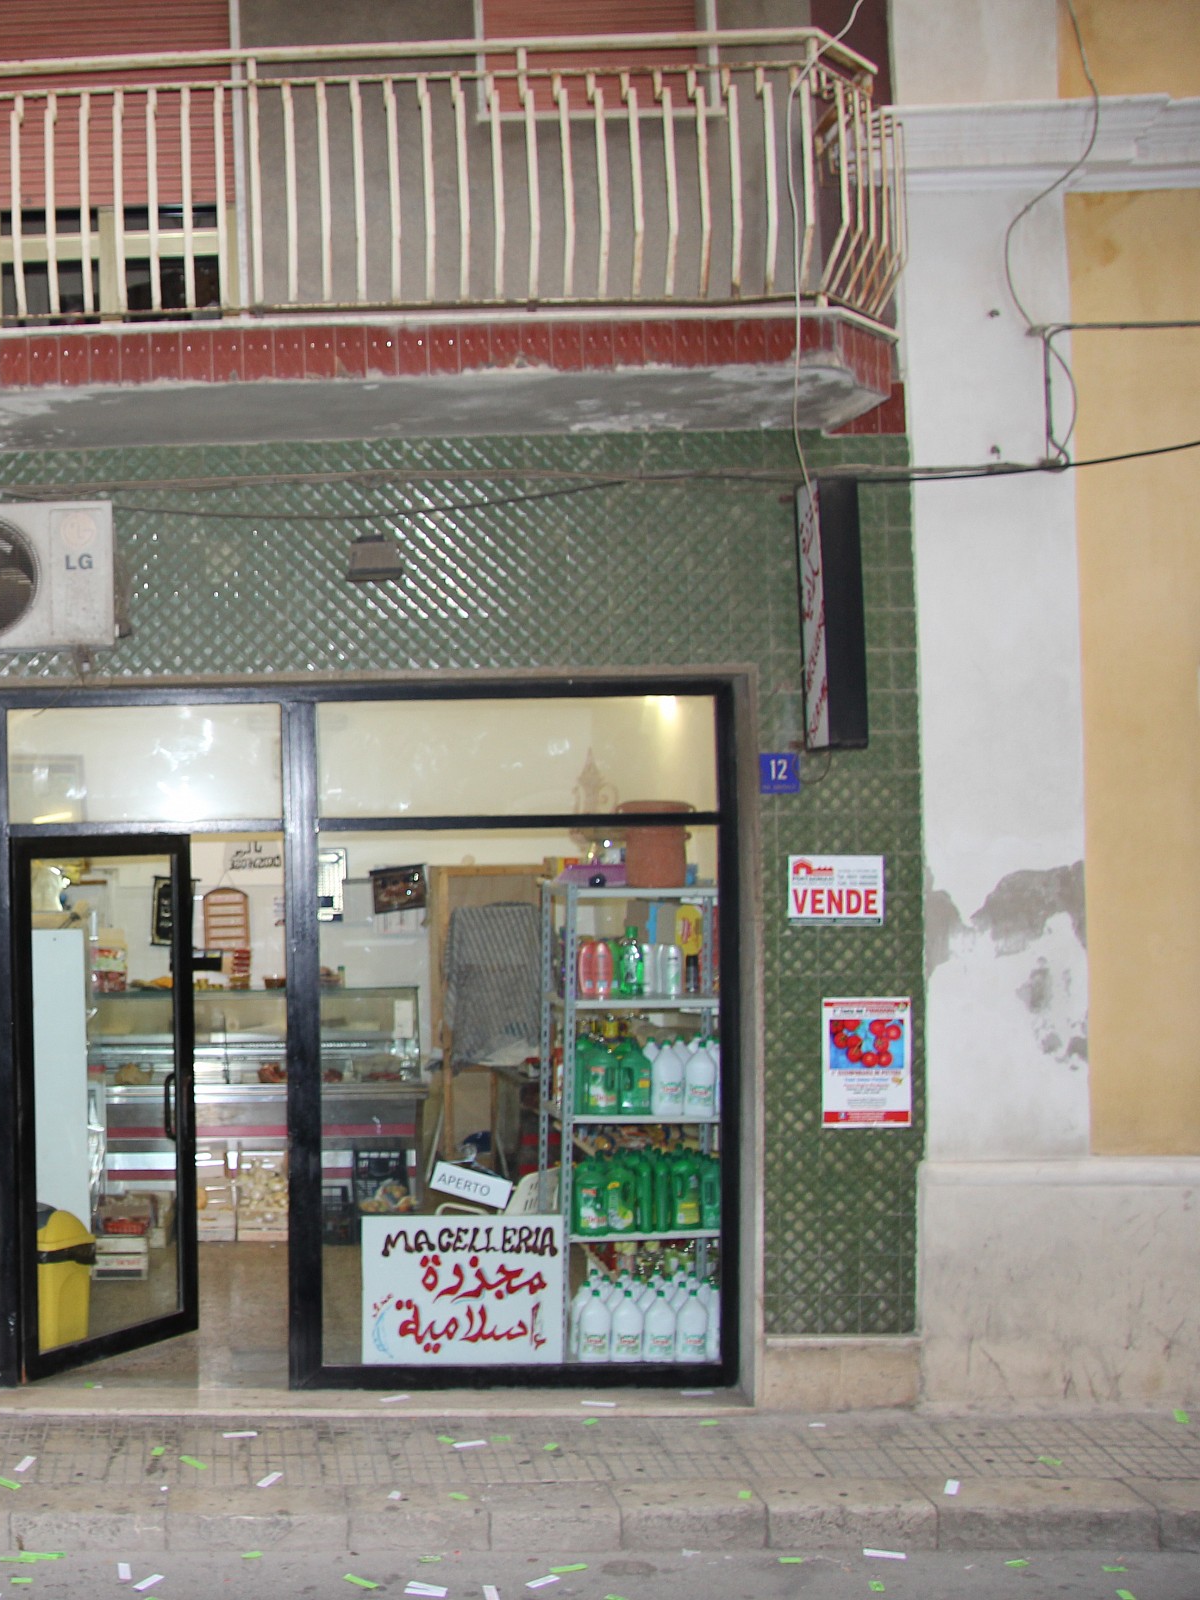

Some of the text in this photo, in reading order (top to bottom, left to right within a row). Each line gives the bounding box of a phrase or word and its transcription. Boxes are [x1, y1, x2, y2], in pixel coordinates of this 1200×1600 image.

[64, 553, 93, 570] LG
[770, 759, 788, 780] 12
[793, 889, 877, 914] VENDE
[437, 1172, 491, 1197] APERTO
[382, 1226, 558, 1257] MACELLERIA
[395, 1299, 547, 1354] إسلامية
